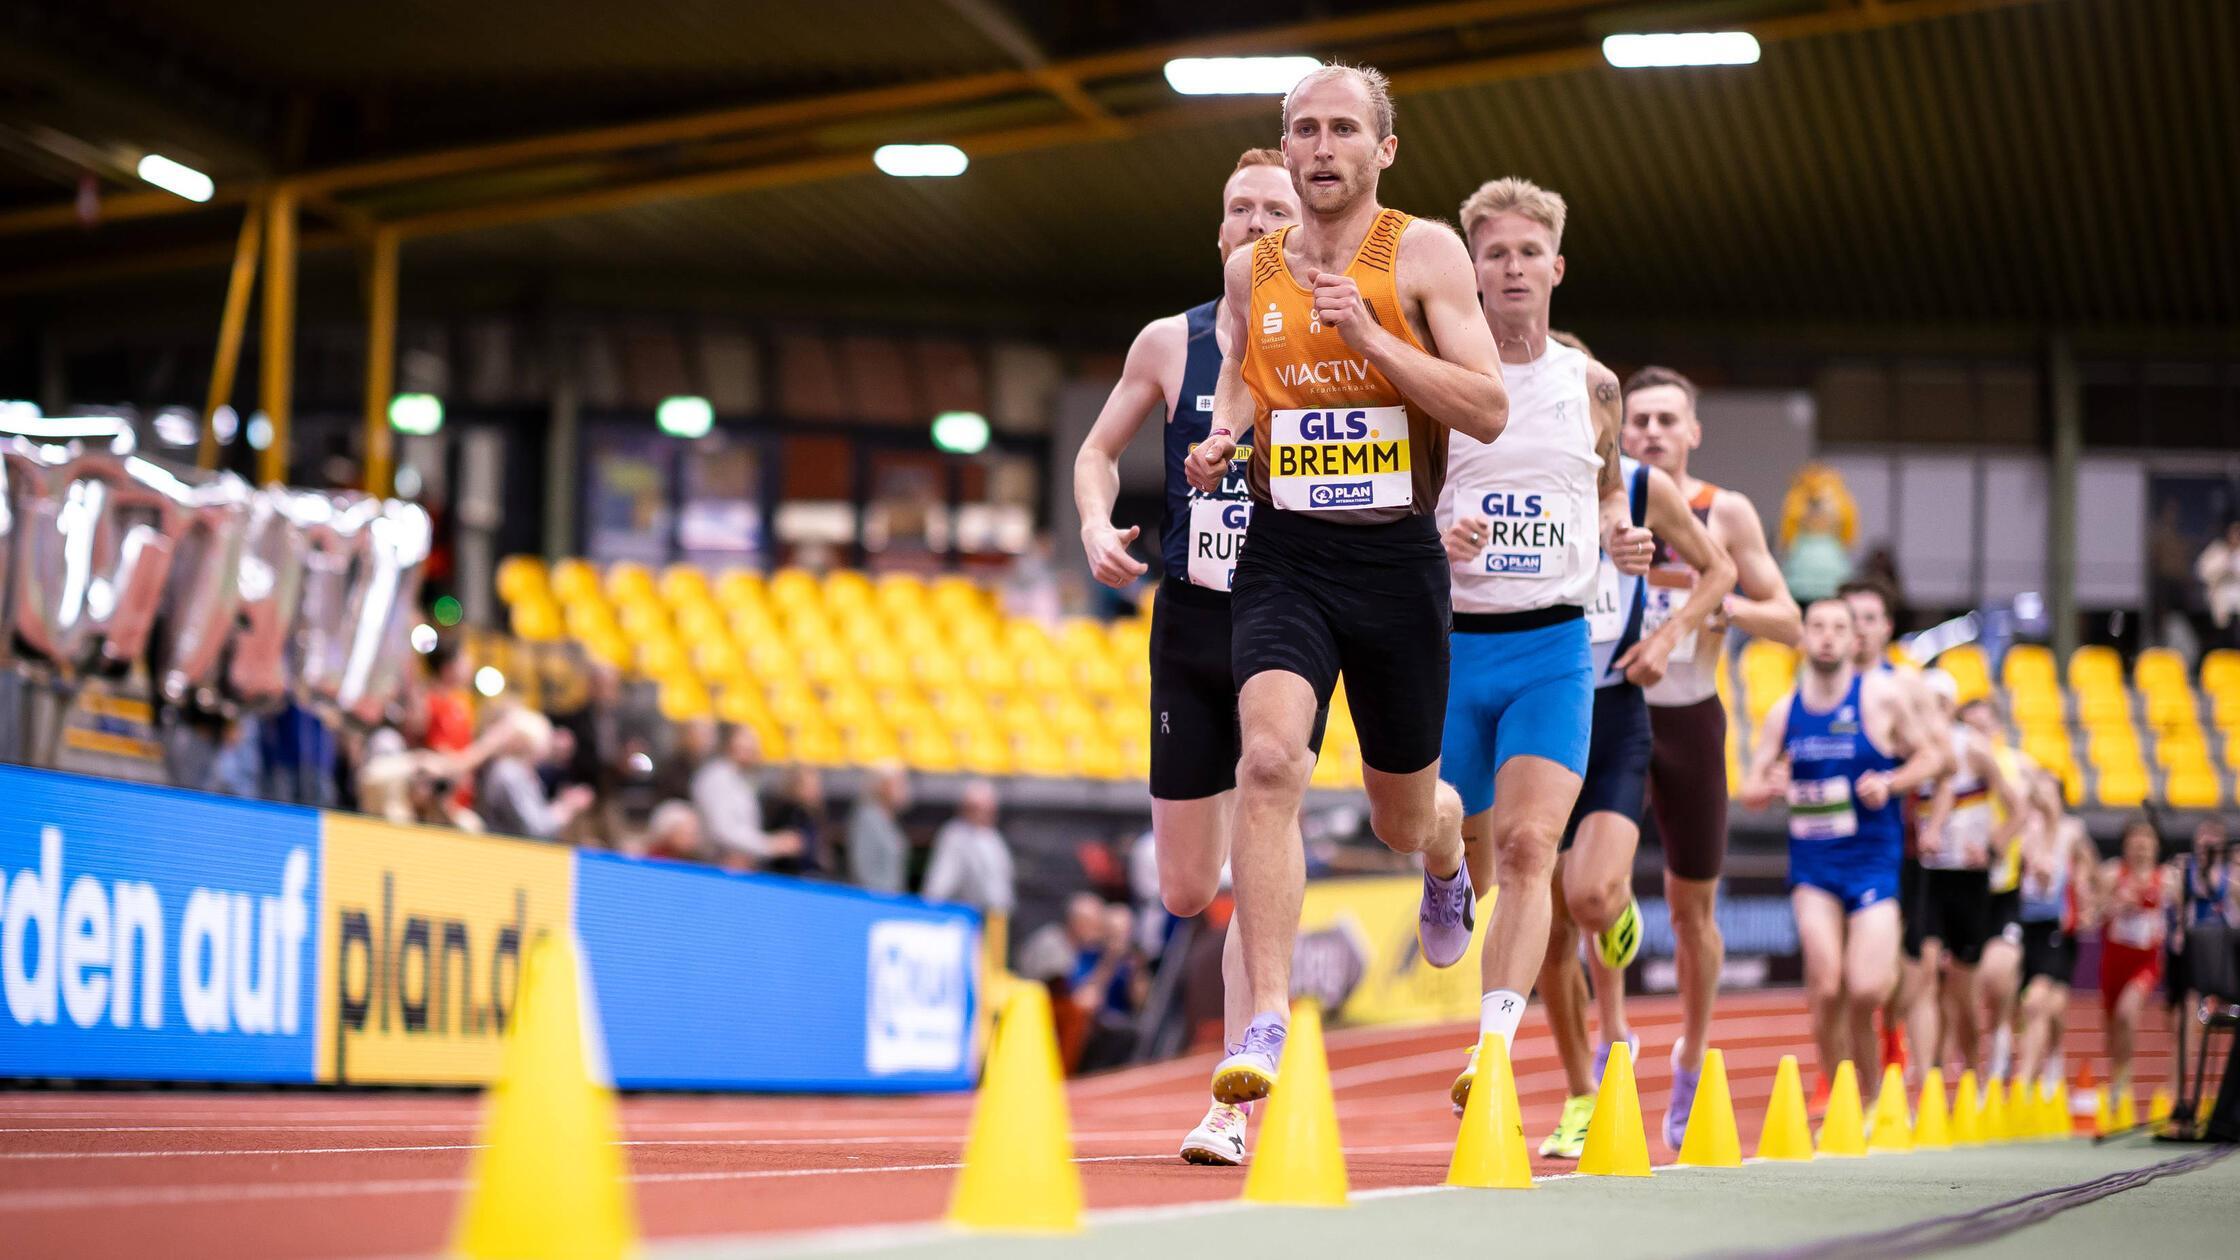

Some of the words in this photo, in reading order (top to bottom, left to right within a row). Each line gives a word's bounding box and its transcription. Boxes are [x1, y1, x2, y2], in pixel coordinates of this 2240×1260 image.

[1275, 359, 1369, 388] VIACTIV
[1280, 442, 1399, 476] BREMM
[1335, 486, 1371, 498] PLAN
[1492, 521, 1565, 547] RKEN
[1508, 556, 1540, 568] PLAN
[0, 825, 164, 1030] den
[179, 847, 310, 1034] auf
[336, 868, 550, 1083] plan.d
